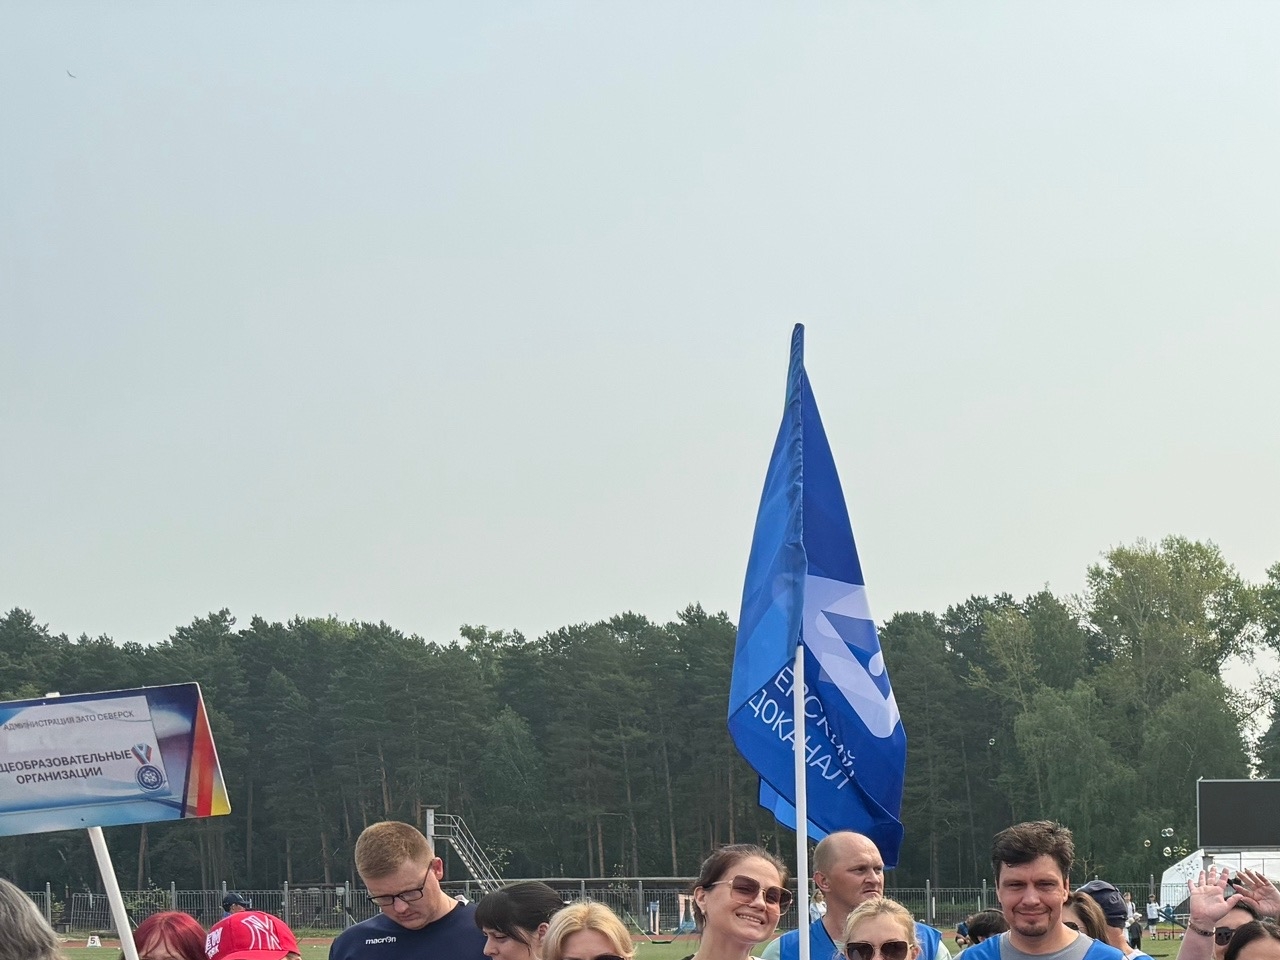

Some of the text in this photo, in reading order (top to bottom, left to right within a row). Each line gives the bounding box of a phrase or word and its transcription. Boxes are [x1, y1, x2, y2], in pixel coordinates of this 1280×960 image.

[3, 710, 135, 731] АДМИНИСТРАЦИЯ ЗАТО СЕВЕРСК
[16, 766, 103, 785] ОРГАНИЗАЦИИ
